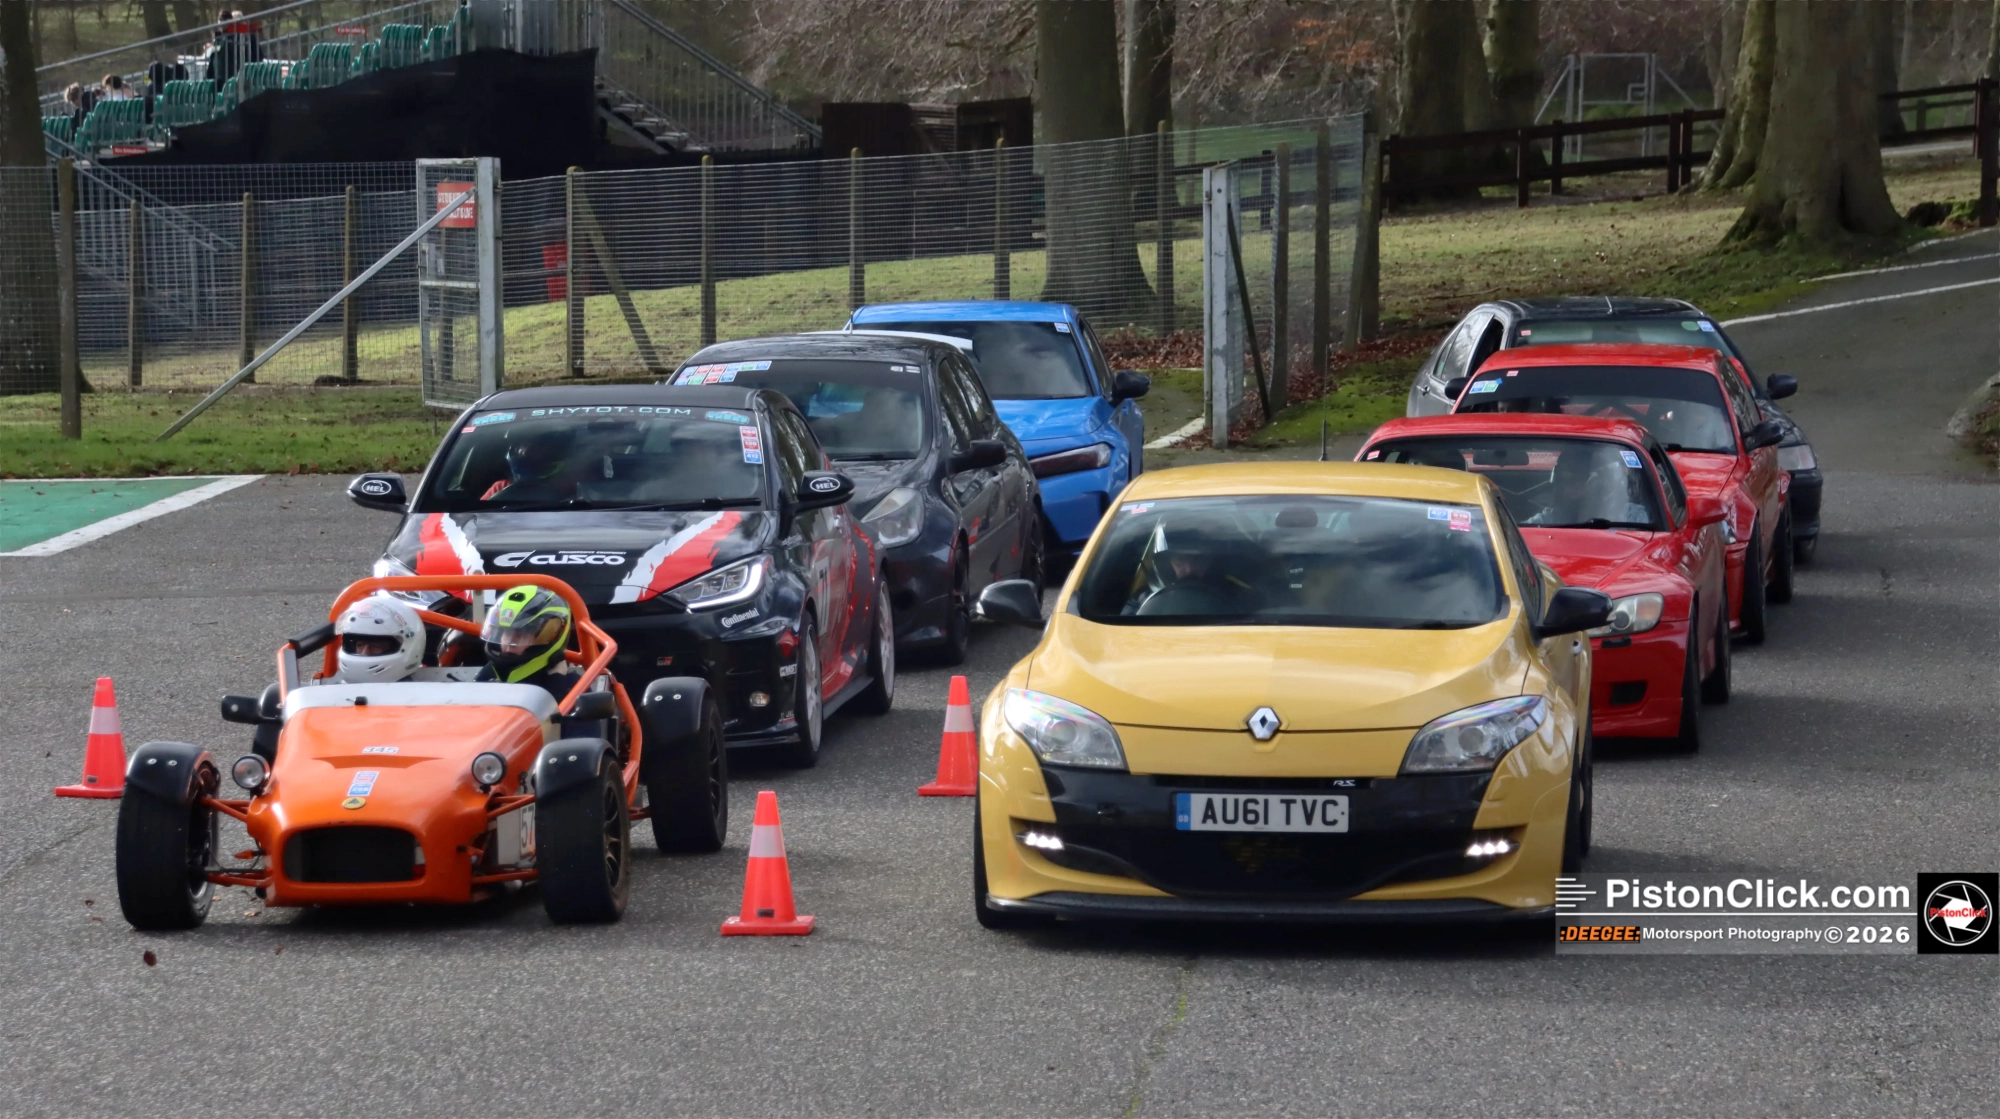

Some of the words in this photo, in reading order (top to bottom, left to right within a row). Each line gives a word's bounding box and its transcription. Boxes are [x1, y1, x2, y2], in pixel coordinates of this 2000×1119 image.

[531, 406, 691, 416] SHYTOT.COM
[815, 482, 837, 490] HEL
[721, 607, 760, 628] Continental
[1201, 797, 1269, 825] AU61
[1280, 798, 1339, 826] TVC
